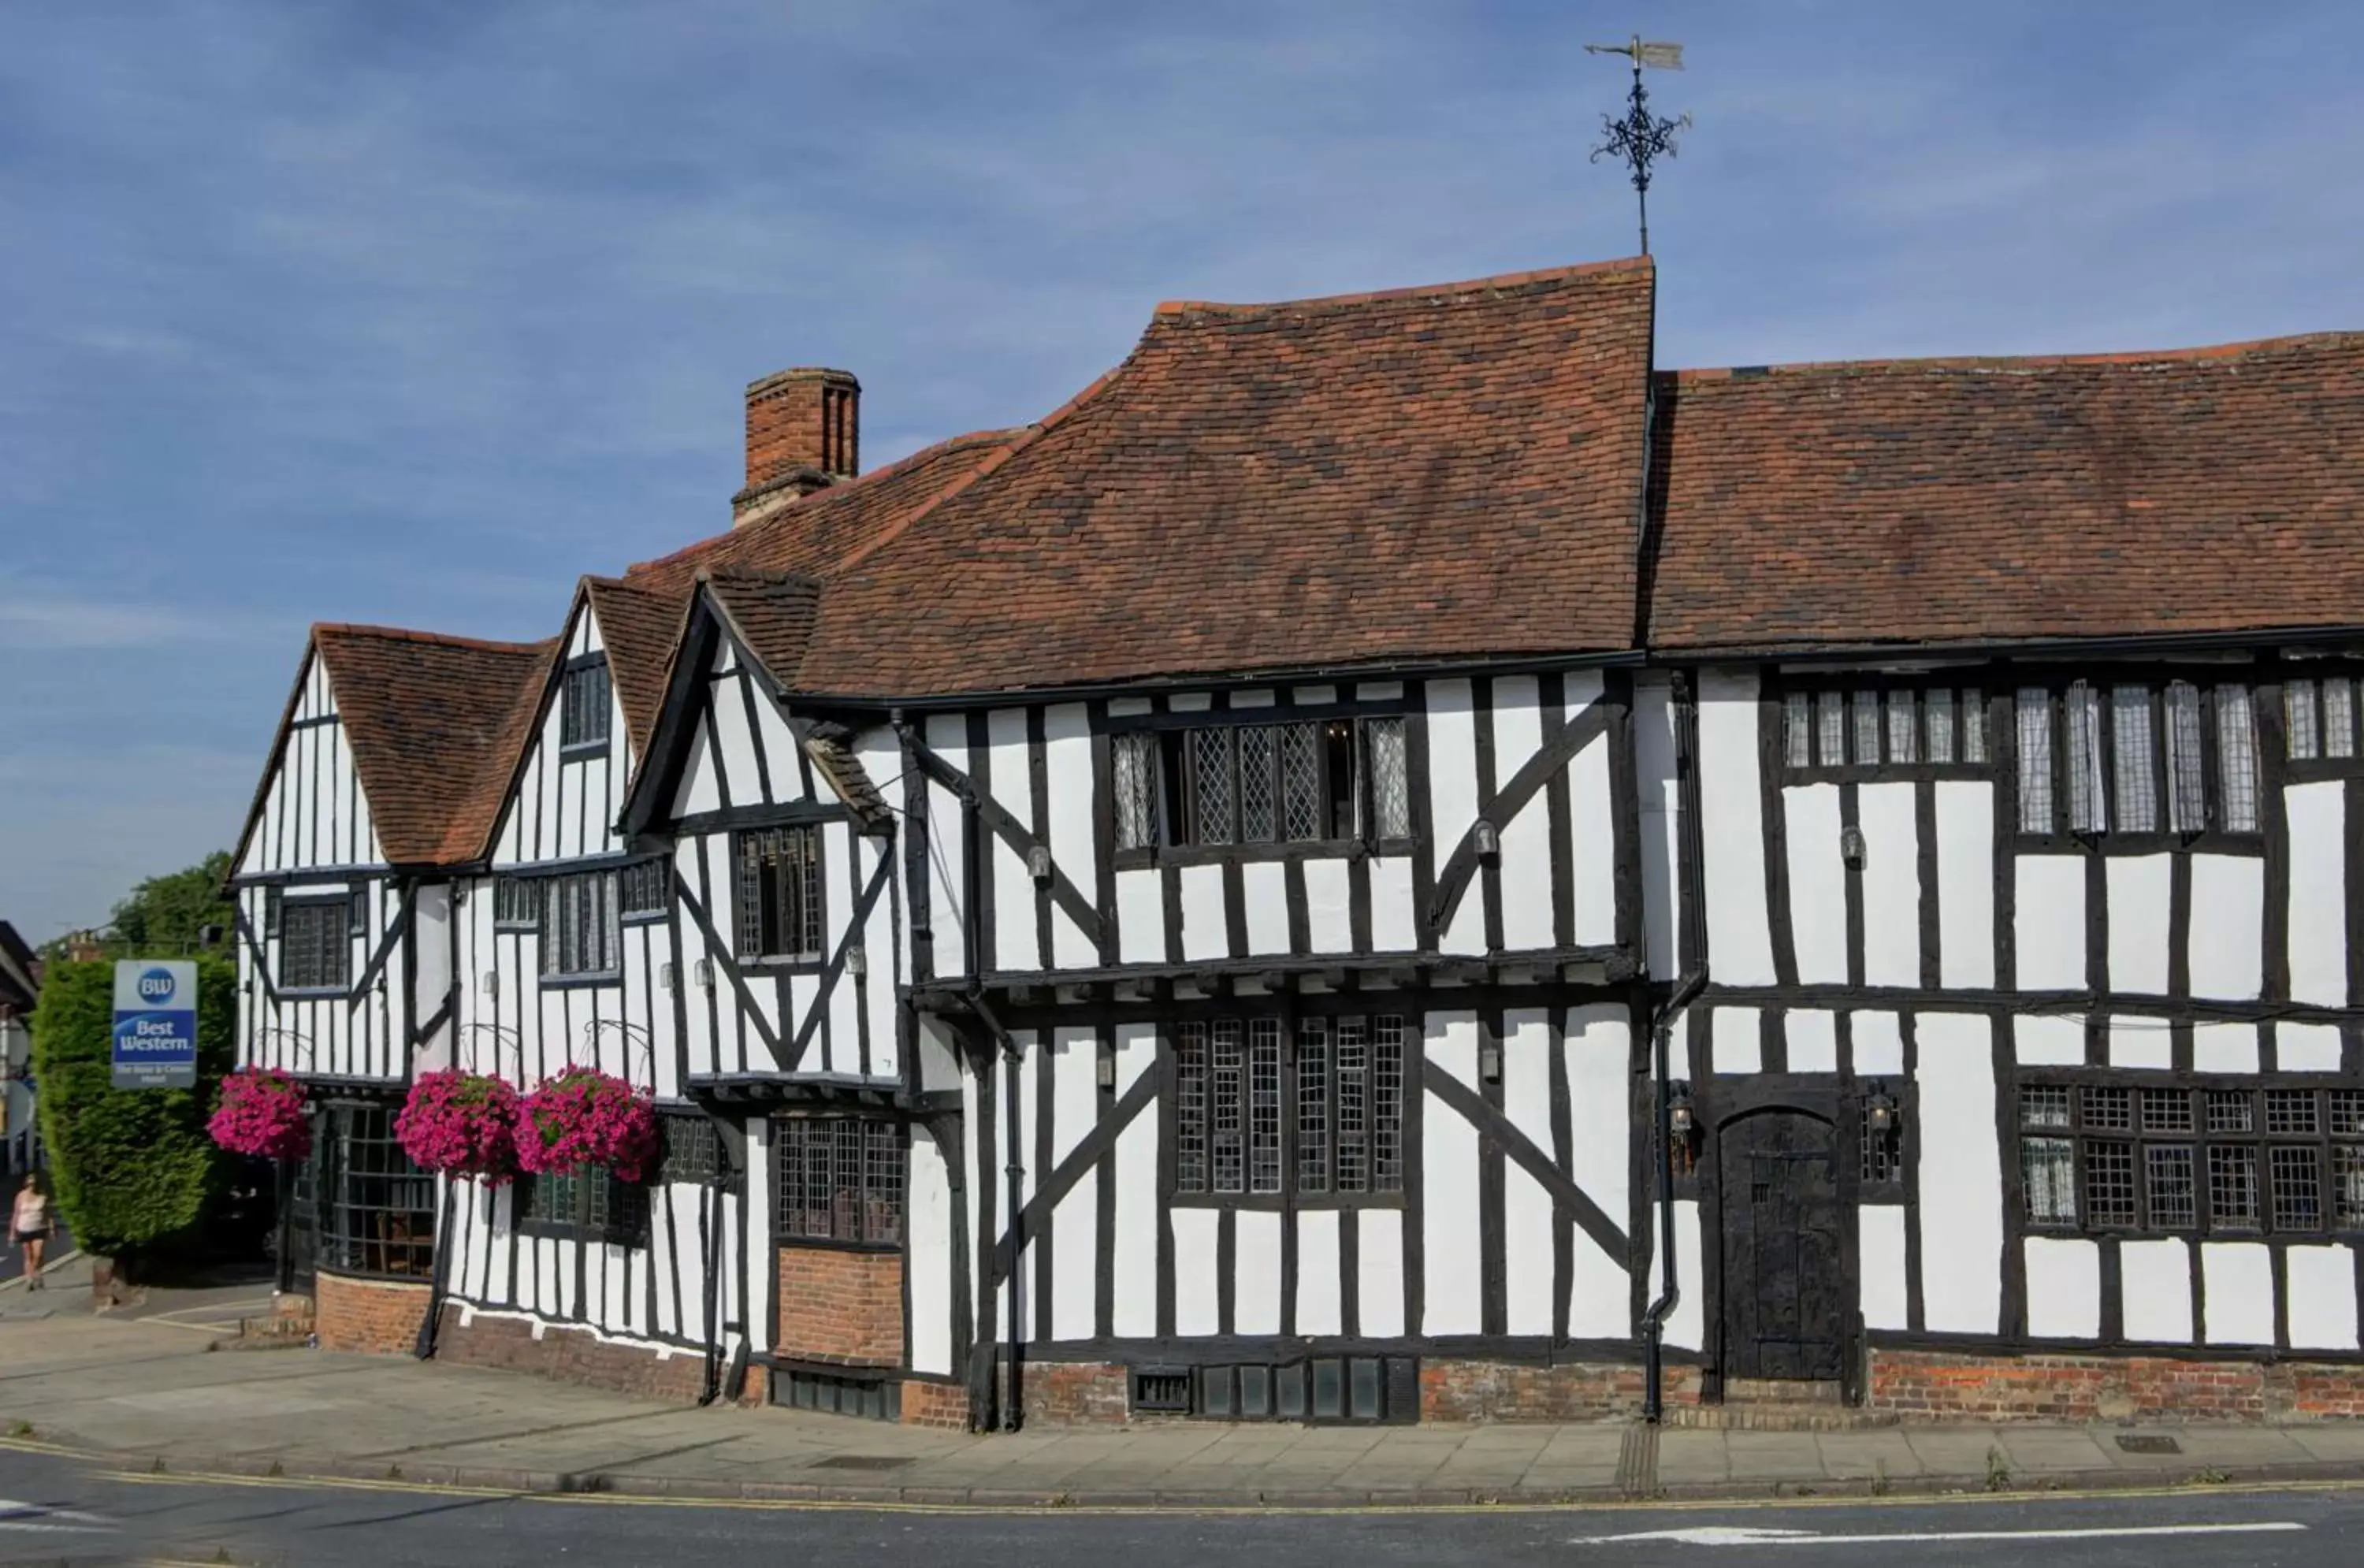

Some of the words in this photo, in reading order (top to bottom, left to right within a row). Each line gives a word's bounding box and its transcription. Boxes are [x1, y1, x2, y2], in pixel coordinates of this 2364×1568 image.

[142, 979, 172, 995] BW
[137, 1021, 174, 1035] Best
[121, 1036, 189, 1051] Western
